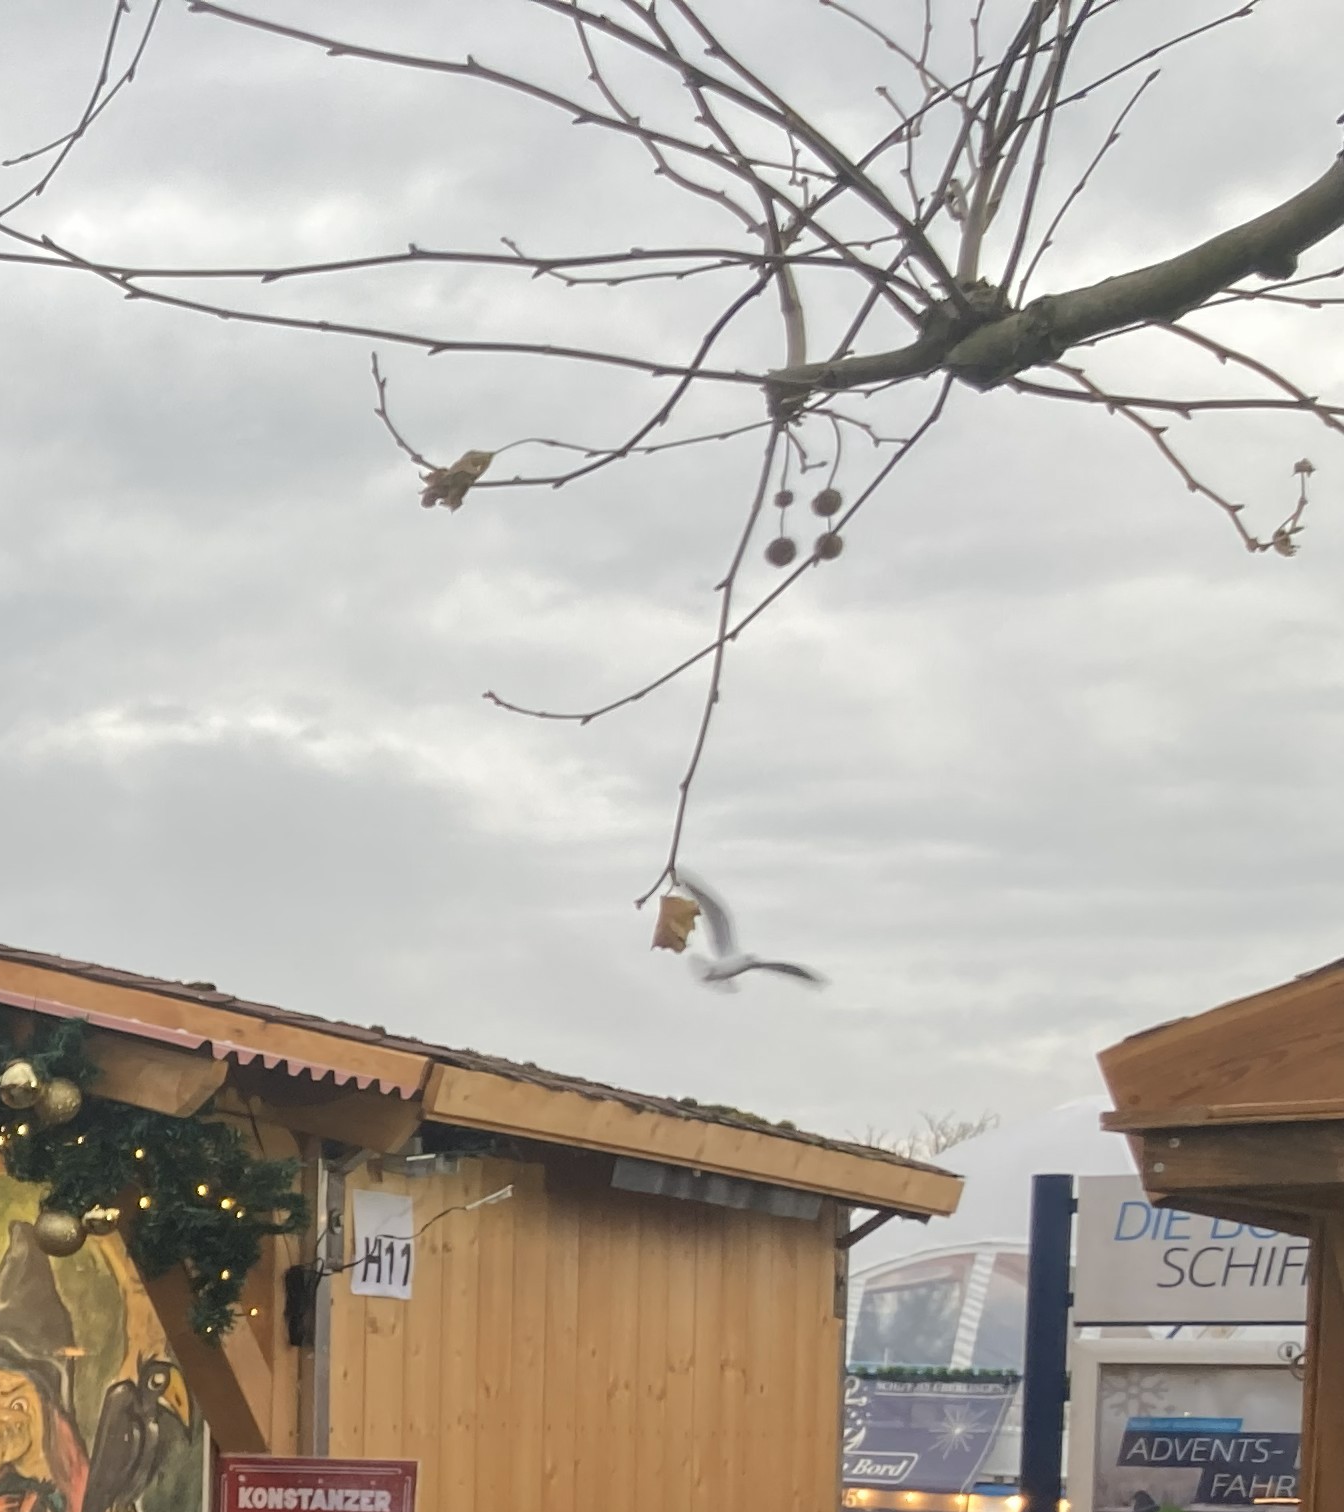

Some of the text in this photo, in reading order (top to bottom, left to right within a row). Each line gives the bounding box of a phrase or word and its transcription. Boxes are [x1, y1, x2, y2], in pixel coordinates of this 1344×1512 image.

[1114, 1201, 1191, 1241] DIE
[361, 1236, 411, 1287] H11
[1156, 1246, 1311, 1288] SCHIF
[1126, 1437, 1285, 1464] ADVENTS-
[852, 1458, 909, 1477] Bord
[238, 1487, 392, 1512] KONSTANZER
